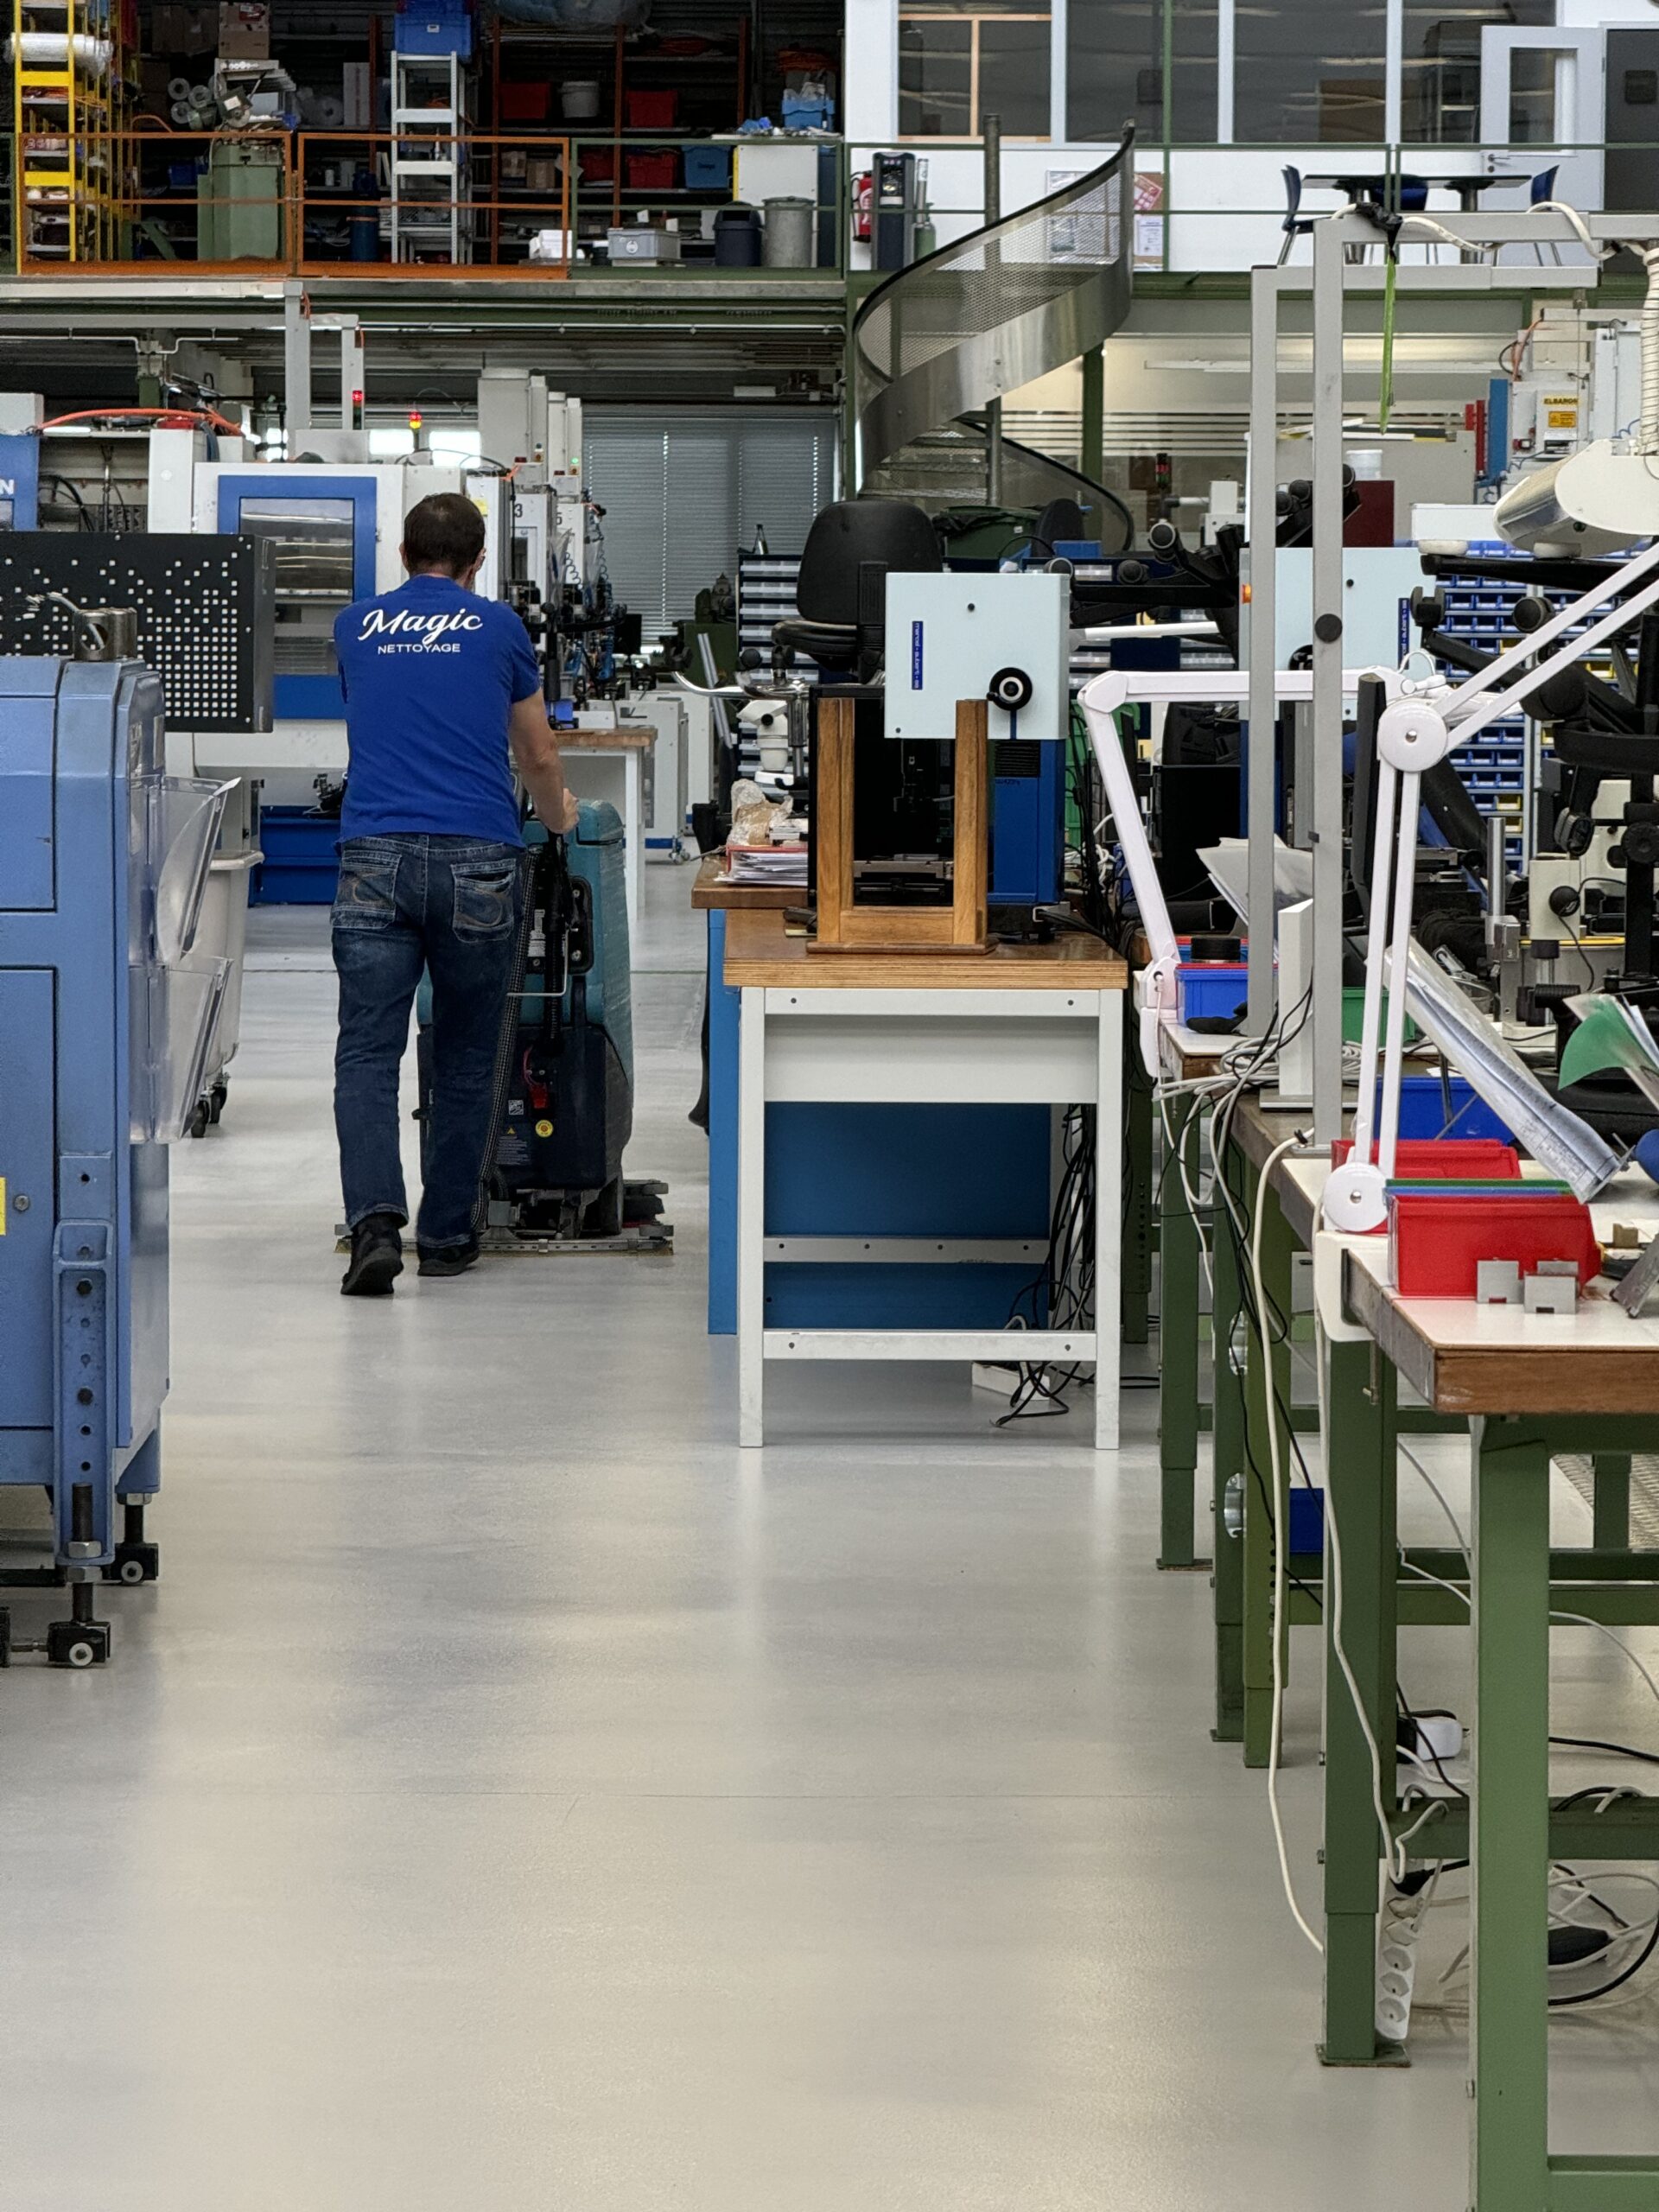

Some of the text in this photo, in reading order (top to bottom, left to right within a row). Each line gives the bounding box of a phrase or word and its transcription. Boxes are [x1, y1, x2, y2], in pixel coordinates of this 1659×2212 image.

[514, 503, 524, 518] 3
[357, 607, 484, 645] Magic
[377, 642, 461, 655] NETTOYAGE
